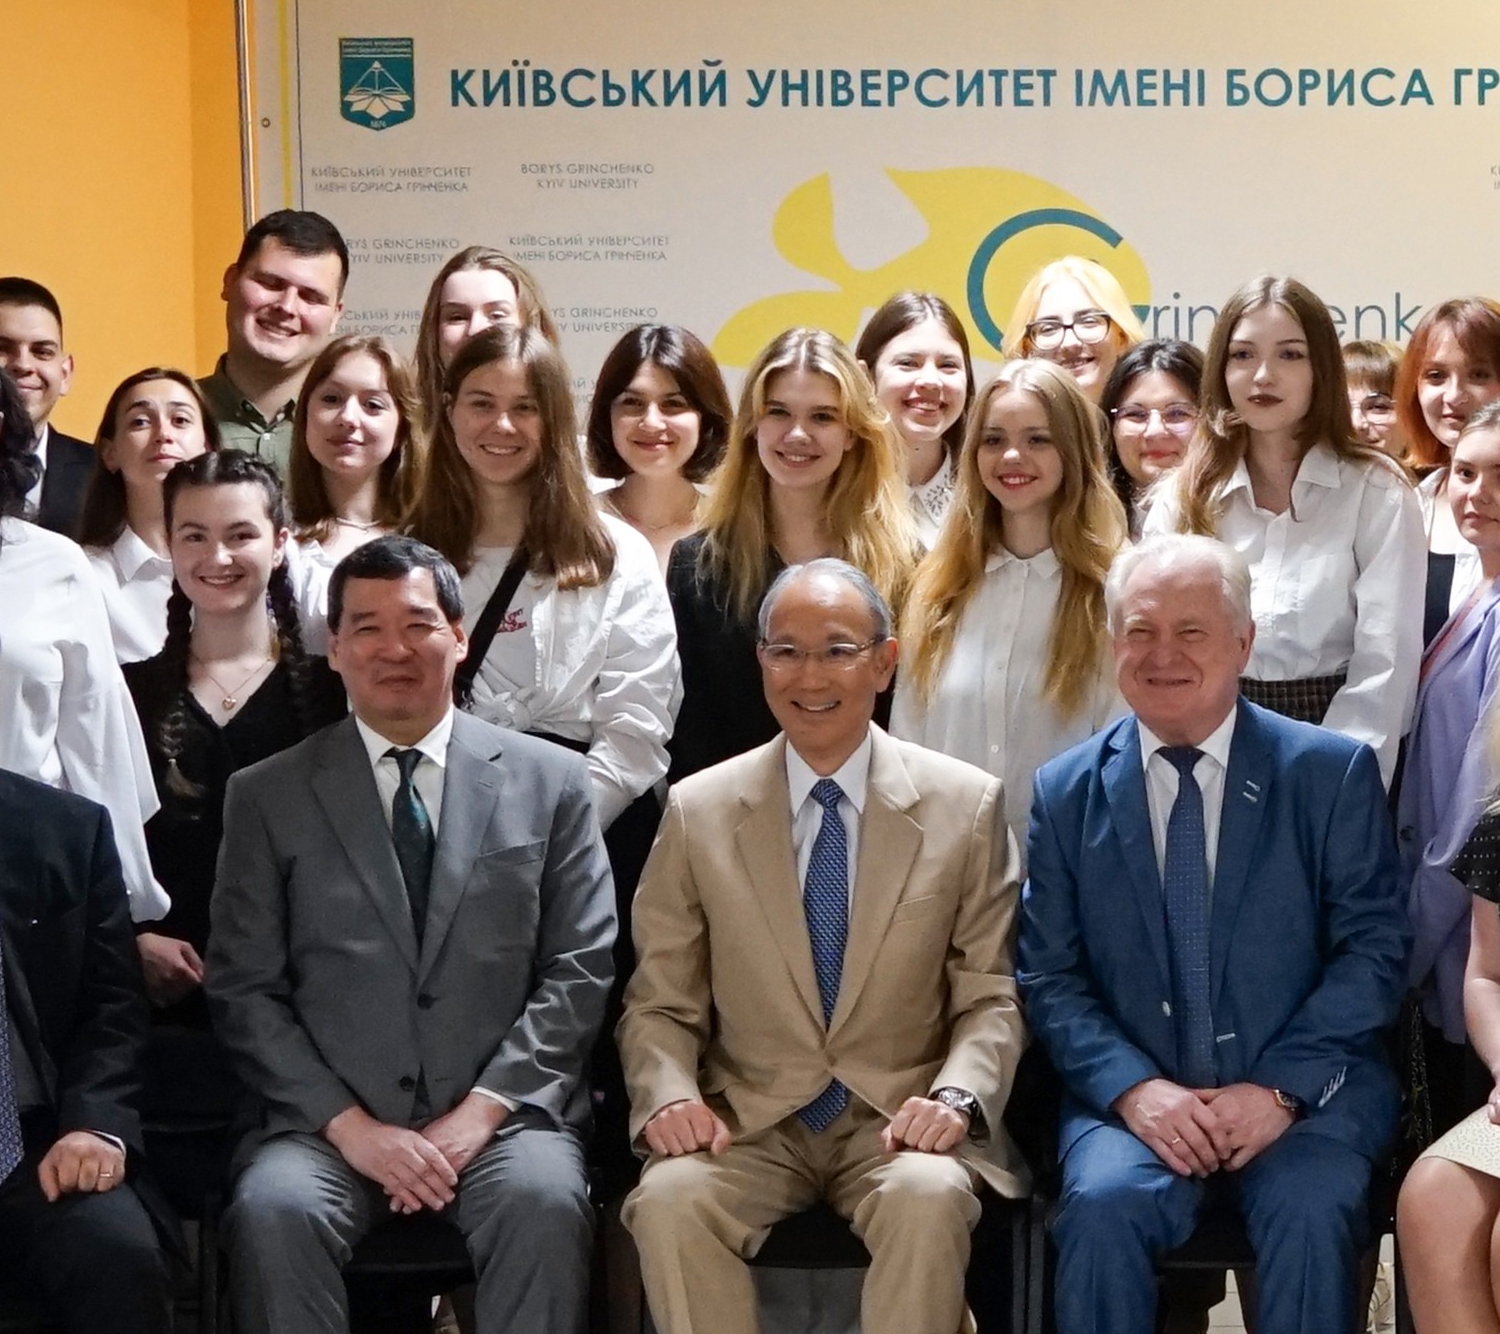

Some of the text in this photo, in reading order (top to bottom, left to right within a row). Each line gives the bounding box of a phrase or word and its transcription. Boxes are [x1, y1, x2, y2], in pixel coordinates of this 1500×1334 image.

[450, 59, 727, 107] КИЇВСЬКИЙ
[746, 68, 1058, 107] УНІВЕРСИТЕТ
[1074, 68, 1205, 107] ІМЕНІ
[1226, 67, 1435, 107] БОРИСА
[311, 165, 472, 178] КИЇВСЬКИЙ УНІВЕРСИТЕТ
[520, 163, 654, 174] BORYS GRINCHENKO
[351, 182, 403, 193] БОРИСА
[406, 182, 469, 193] ГРІНЧЕНКА
[537, 178, 638, 189] KYIV UNIVERSITY
[345, 238, 460, 249] RYS GRINCHENKO
[509, 234, 669, 246] КИЇВСЬКИЙ УНІВЕРСИТЕТ
[351, 253, 444, 264] YIV UNIVERSITY
[550, 251, 601, 262] БОРИСА
[605, 251, 667, 262] ГРІНЧЕНКА
[344, 309, 389, 320] СЬКИЙ
[570, 307, 658, 318] GRINCHENKO
